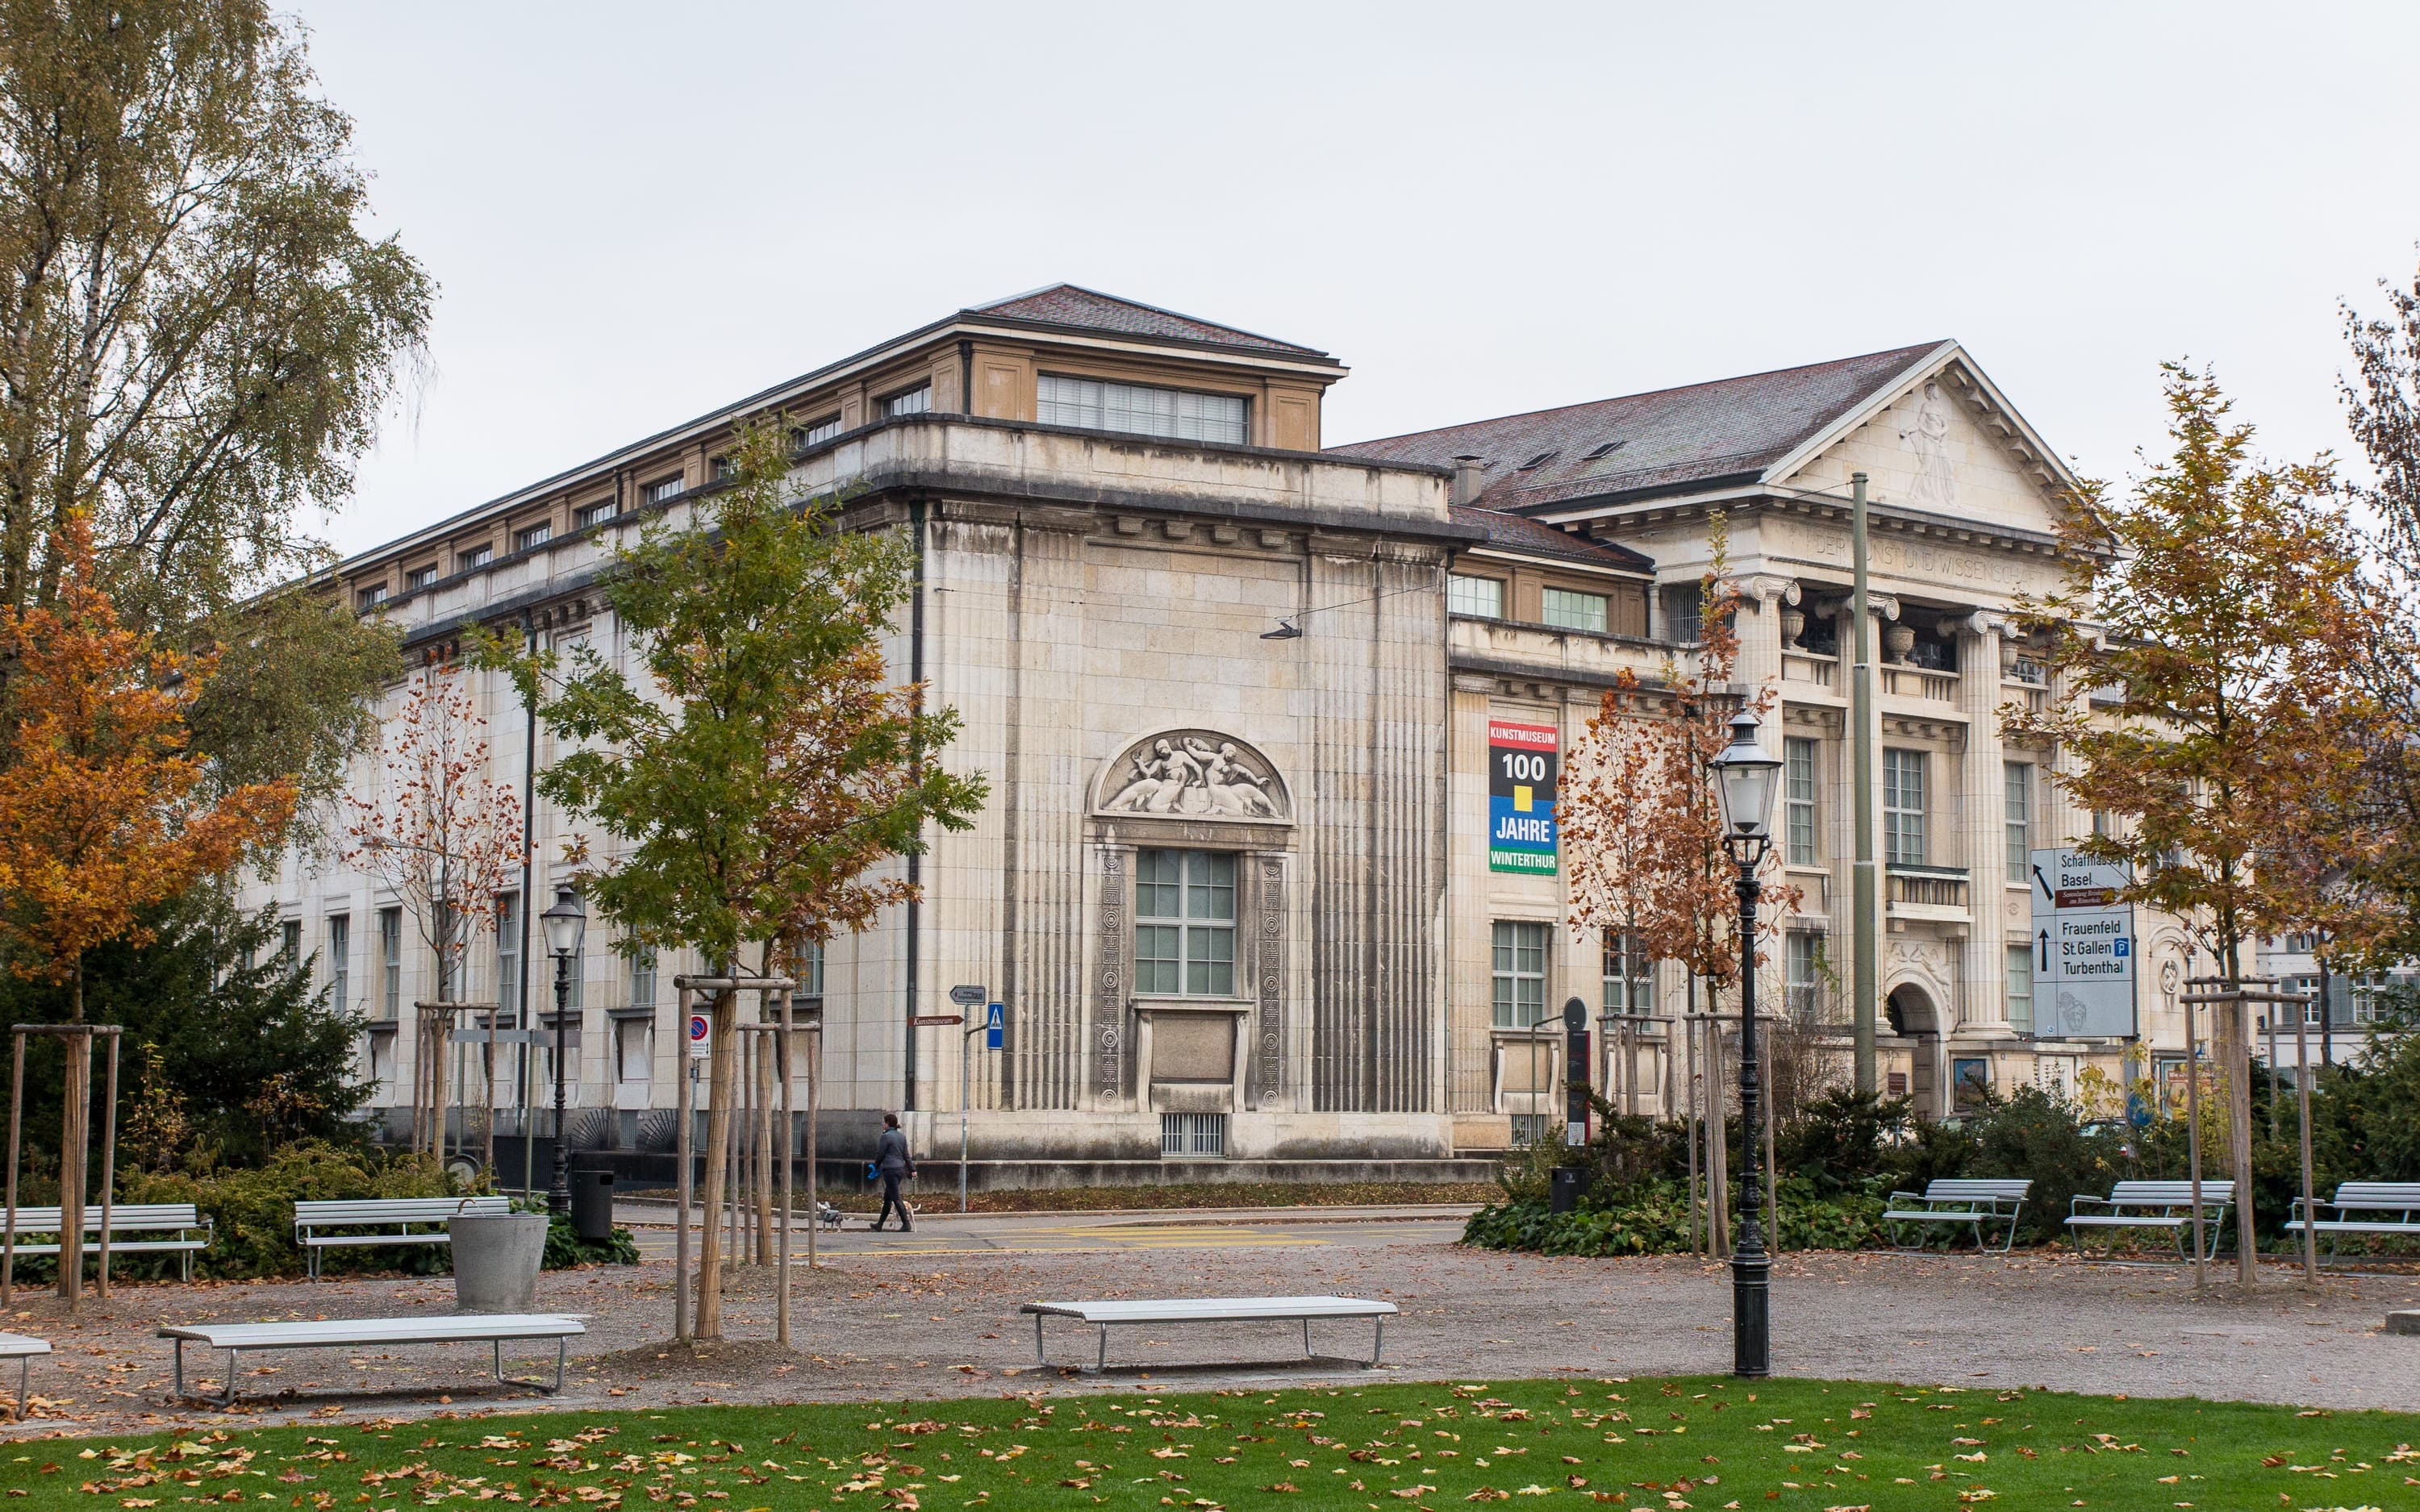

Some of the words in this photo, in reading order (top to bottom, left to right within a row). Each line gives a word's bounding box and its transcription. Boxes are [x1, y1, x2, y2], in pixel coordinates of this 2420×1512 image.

[1816, 535, 1846, 558] DER
[1865, 543, 1901, 566] UNST
[1905, 548, 1934, 571] UND
[1490, 727, 1556, 744] KUNSTMUSEUM
[1503, 753, 1546, 781] 100
[1496, 817, 1550, 843] JAHRE
[1491, 851, 1556, 868] WINTERTHUR
[2061, 873, 2092, 887] Basel
[2062, 920, 2121, 935] Frauenfeld
[2064, 960, 2123, 975] Turbenthal
[913, 1018, 953, 1026] Kunstmuseum
